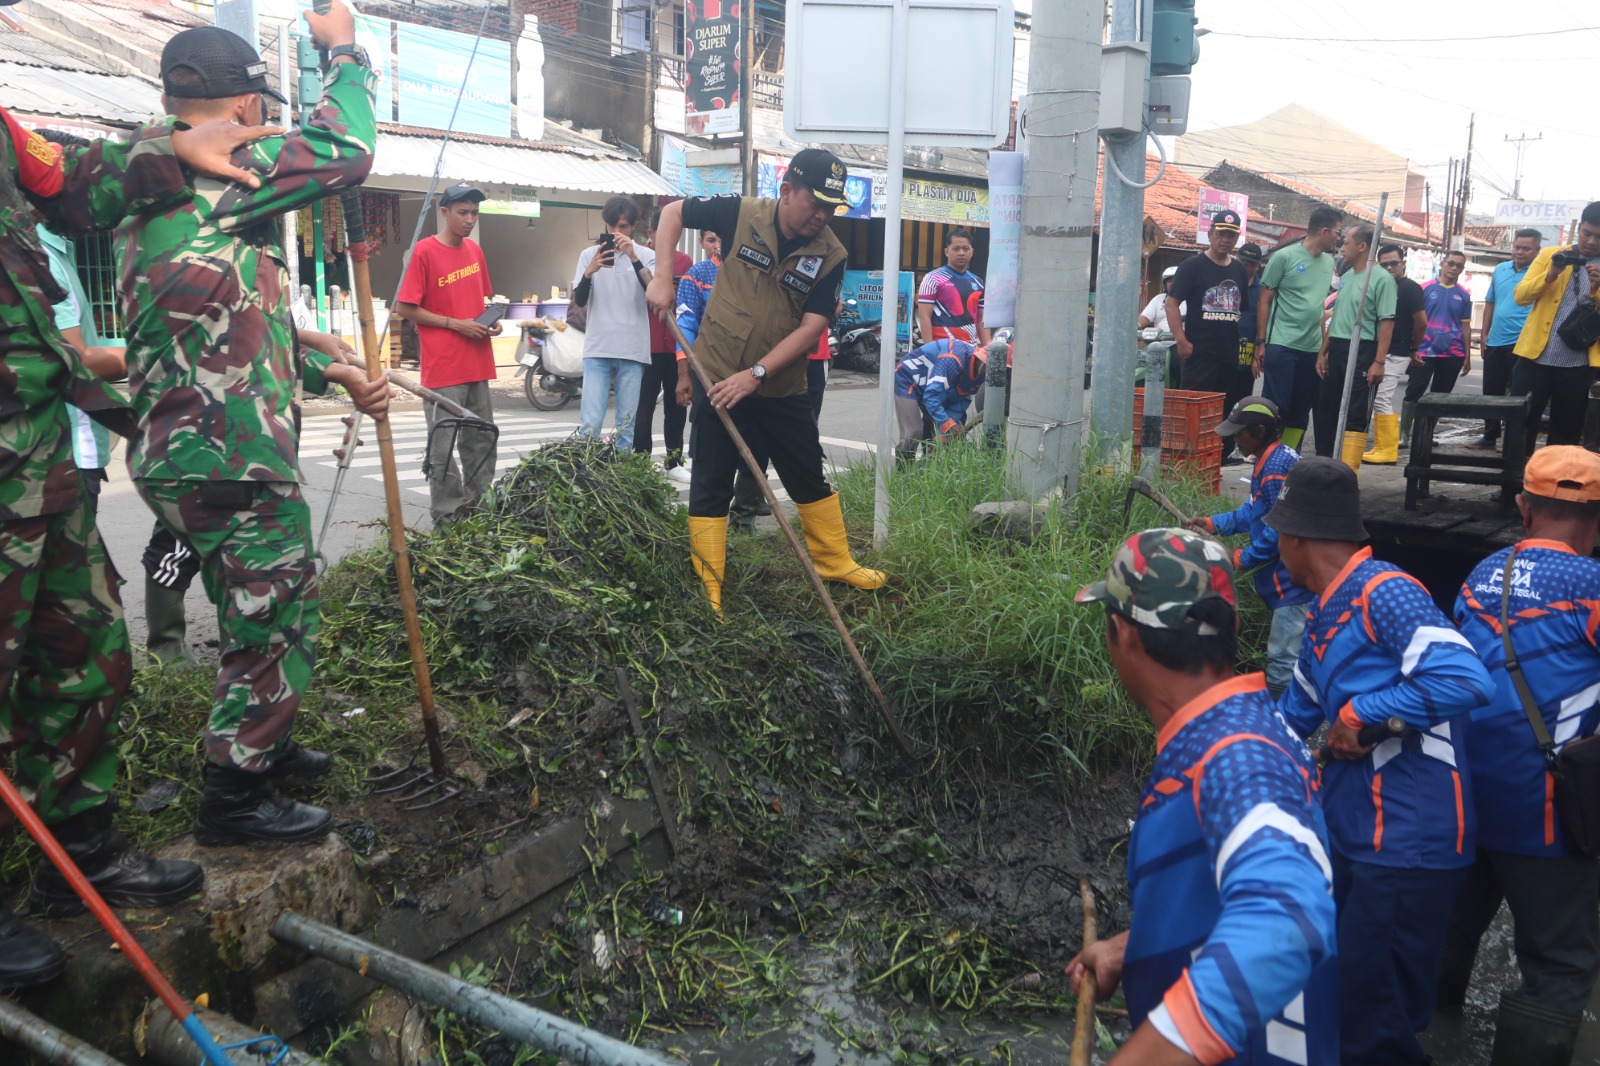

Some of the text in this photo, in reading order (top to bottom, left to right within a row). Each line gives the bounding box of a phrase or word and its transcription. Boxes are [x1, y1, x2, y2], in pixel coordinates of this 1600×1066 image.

[695, 23, 731, 40] DJARUM
[699, 36, 727, 51] SUPER
[704, 71, 725, 87] SUPER
[957, 189, 978, 204] DUA
[1499, 203, 1567, 217] APOTEK
[438, 262, 480, 287] E-RETRIBUSI
[859, 284, 883, 292] LITOM
[858, 293, 883, 301] BRILIN
[1514, 588, 1541, 600] TEGAL
